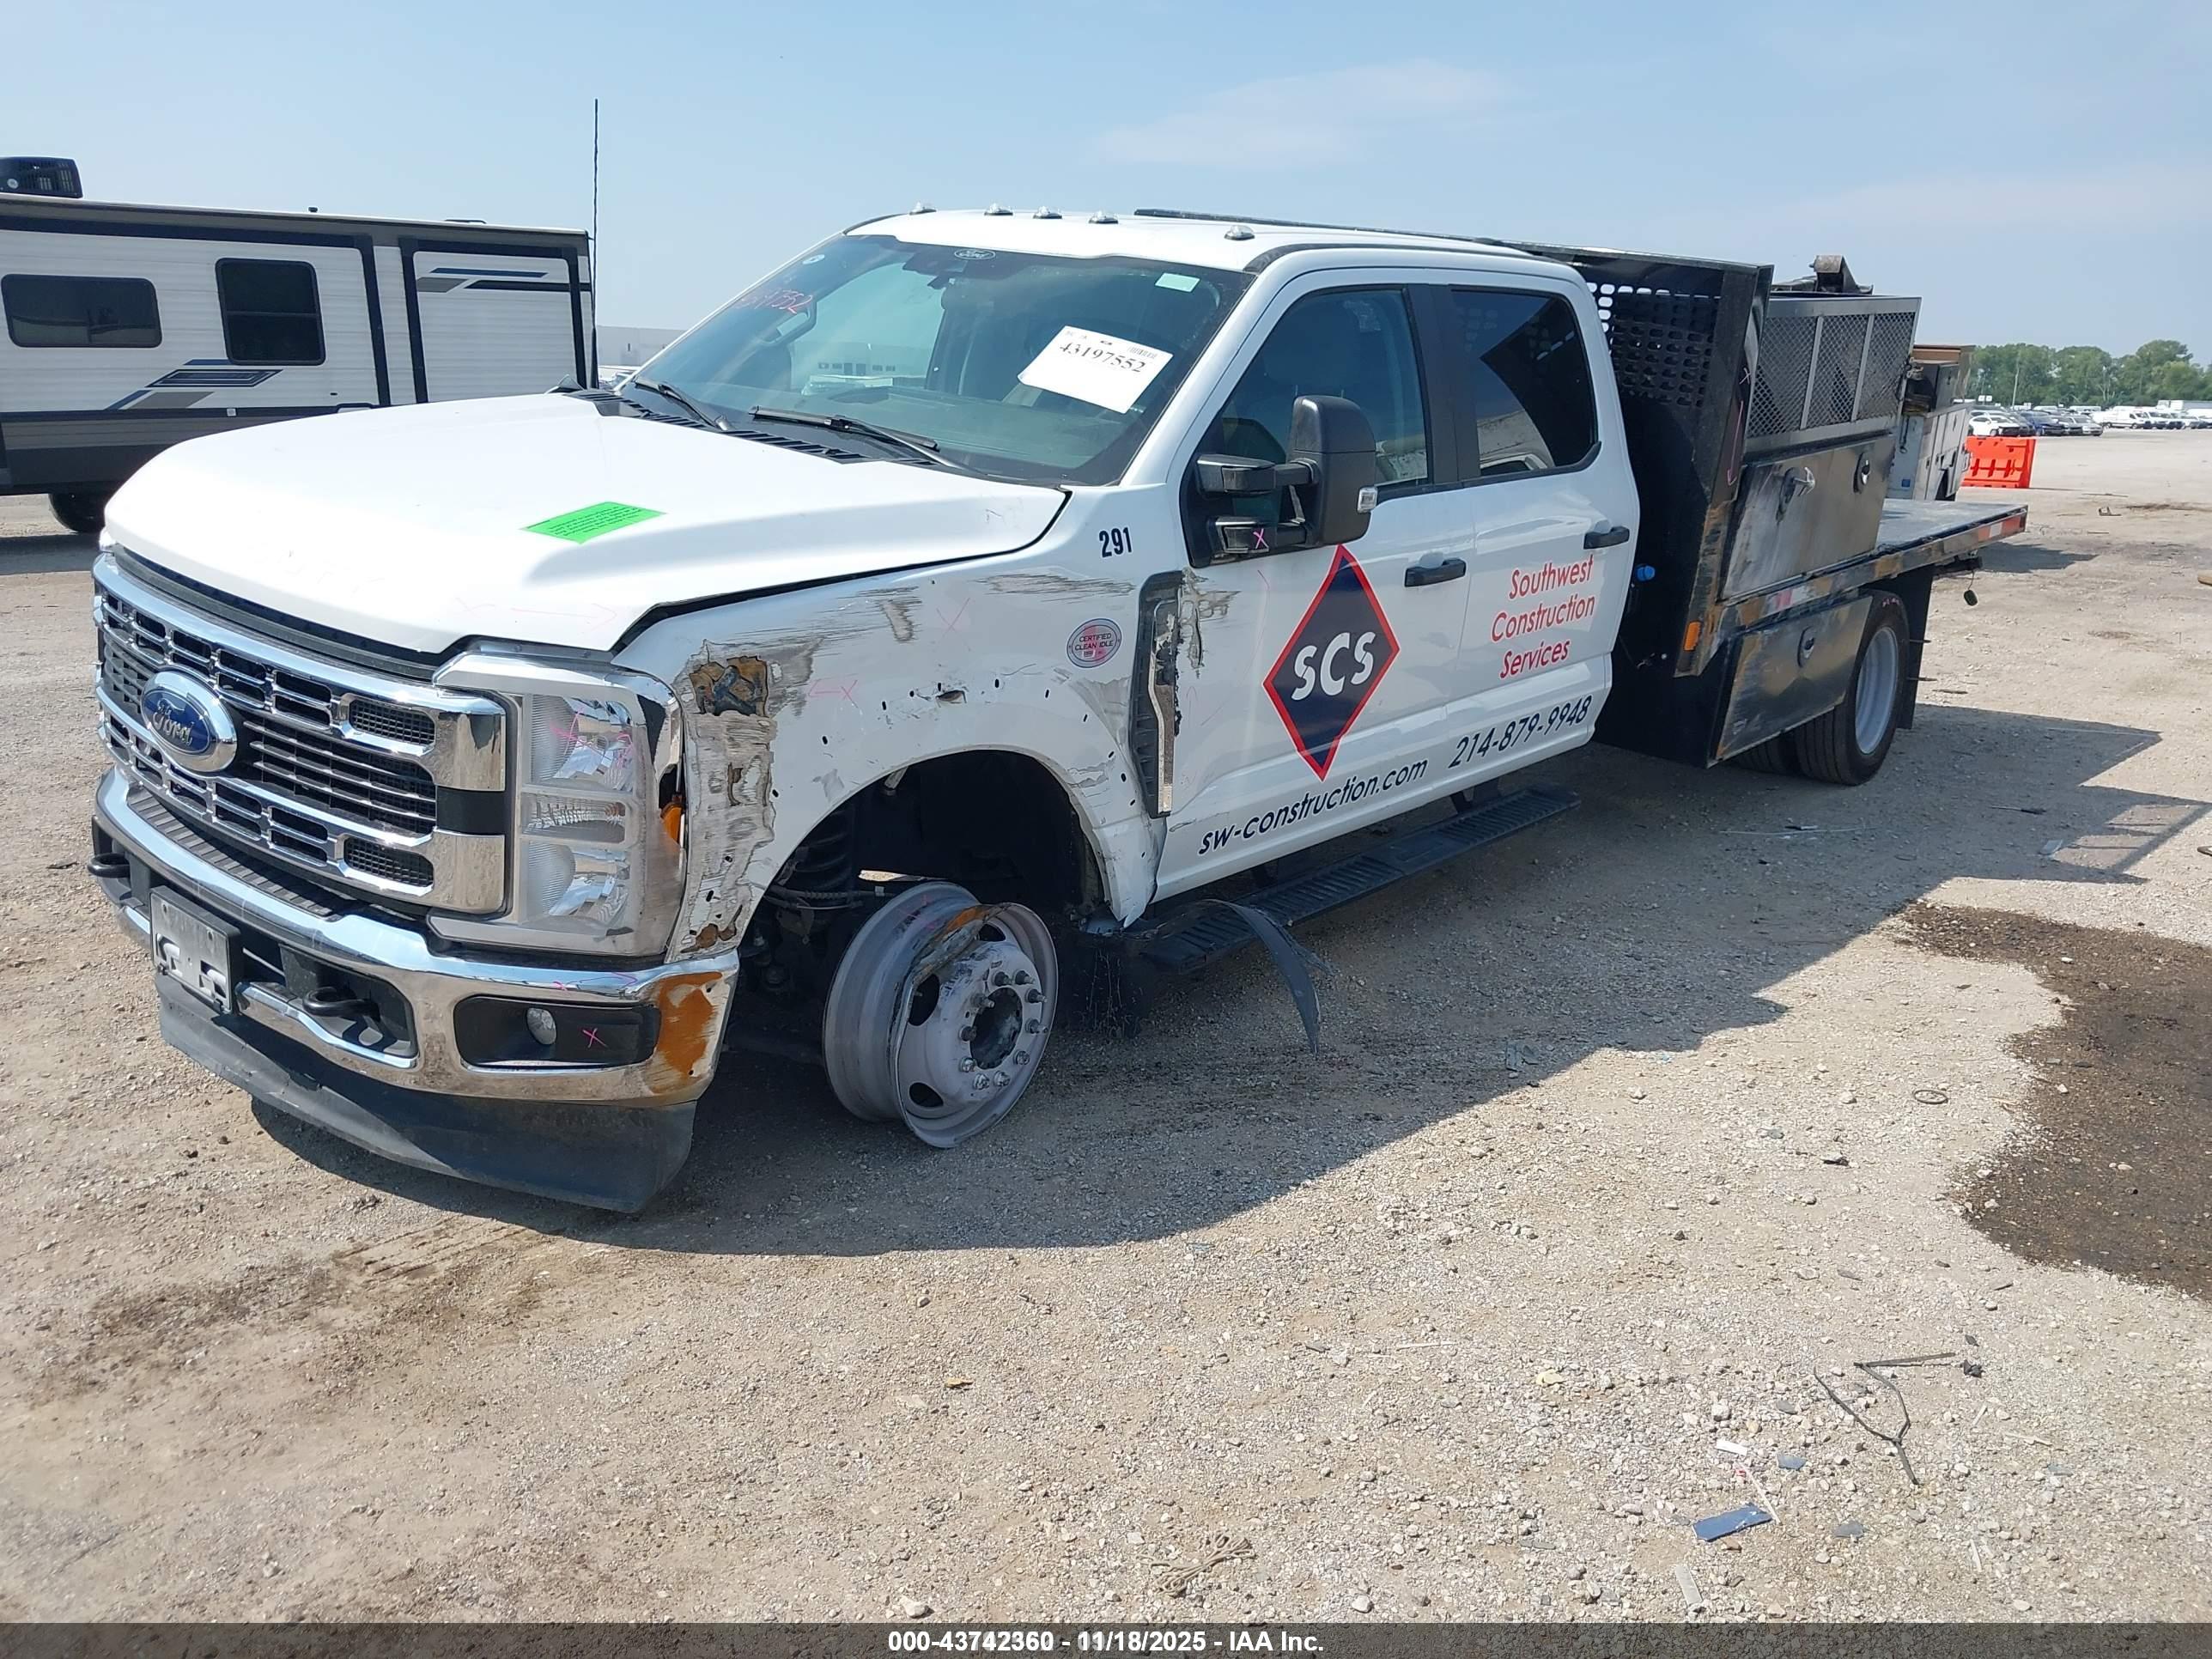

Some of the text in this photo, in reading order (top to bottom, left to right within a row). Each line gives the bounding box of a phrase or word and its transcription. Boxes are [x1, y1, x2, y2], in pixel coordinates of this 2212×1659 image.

[1060, 343, 1146, 373] 43197552
[1098, 526, 1133, 558] 291
[1509, 553, 1595, 599] Southwest
[1079, 633, 1111, 642] CERTIFIED
[1492, 593, 1595, 642] Construction
[1291, 631, 1376, 701] SCS
[1499, 640, 1571, 679] Services
[153, 697, 194, 746] Ford
[1448, 696, 1592, 769] 214-879-9948
[1199, 759, 1428, 854] sw-construction.com
